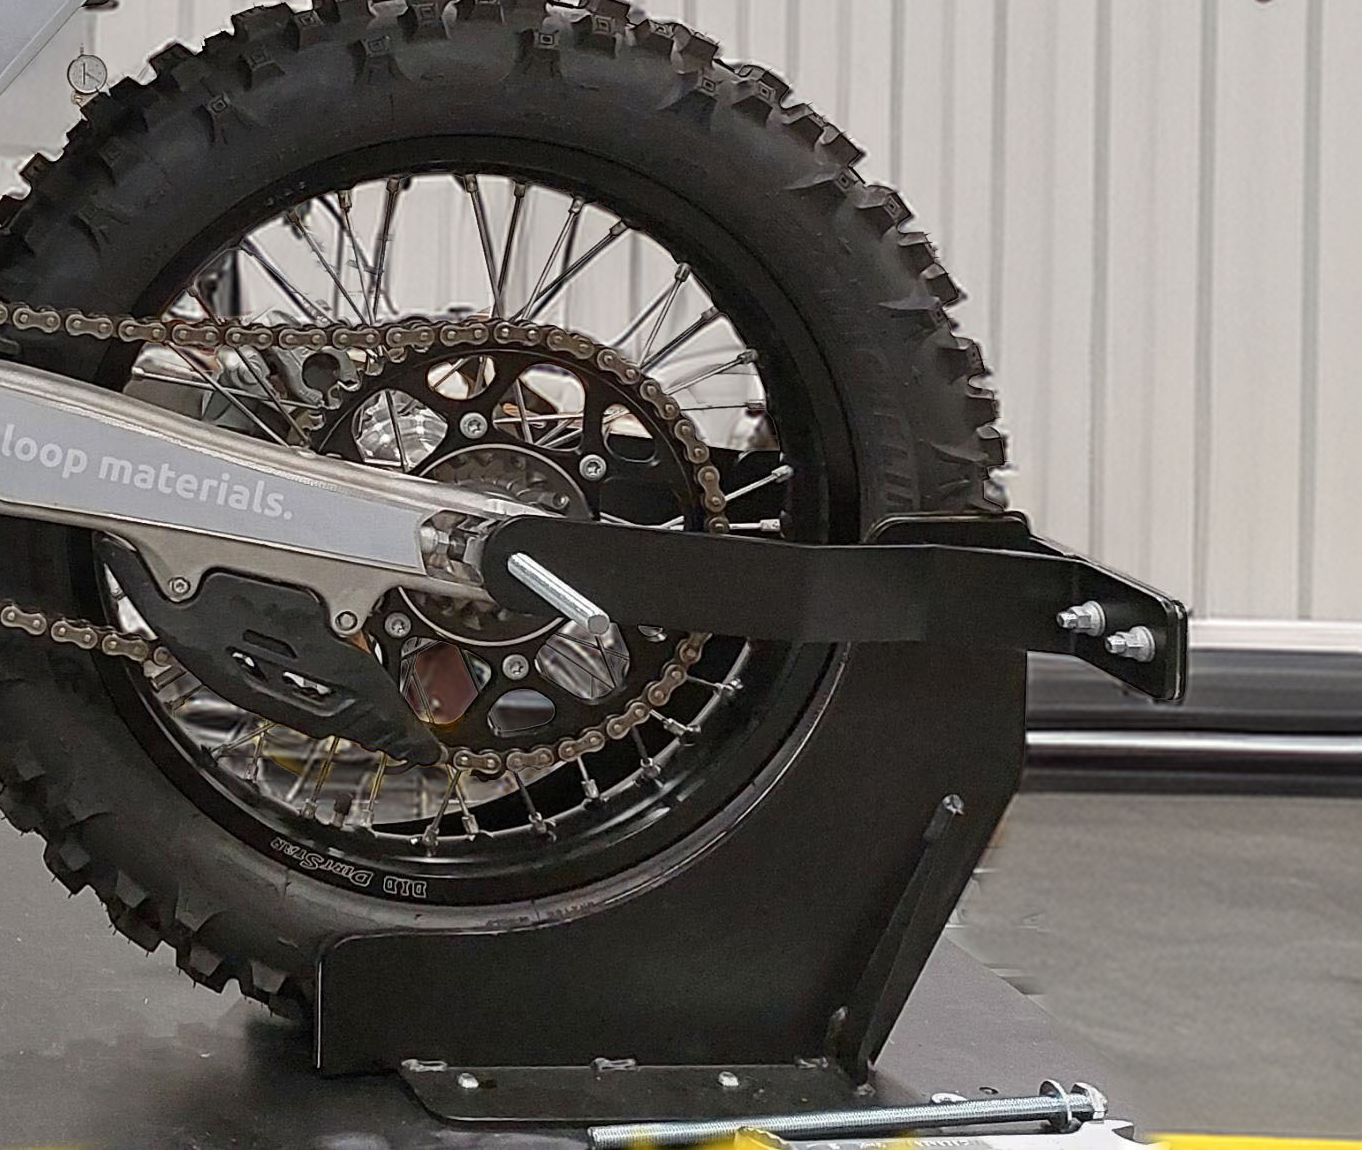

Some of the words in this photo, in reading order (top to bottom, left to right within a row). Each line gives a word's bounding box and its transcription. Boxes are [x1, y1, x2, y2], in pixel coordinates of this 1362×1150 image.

[0, 421, 90, 480] loop
[98, 453, 294, 522] materials.
[383, 876, 427, 898] DID
